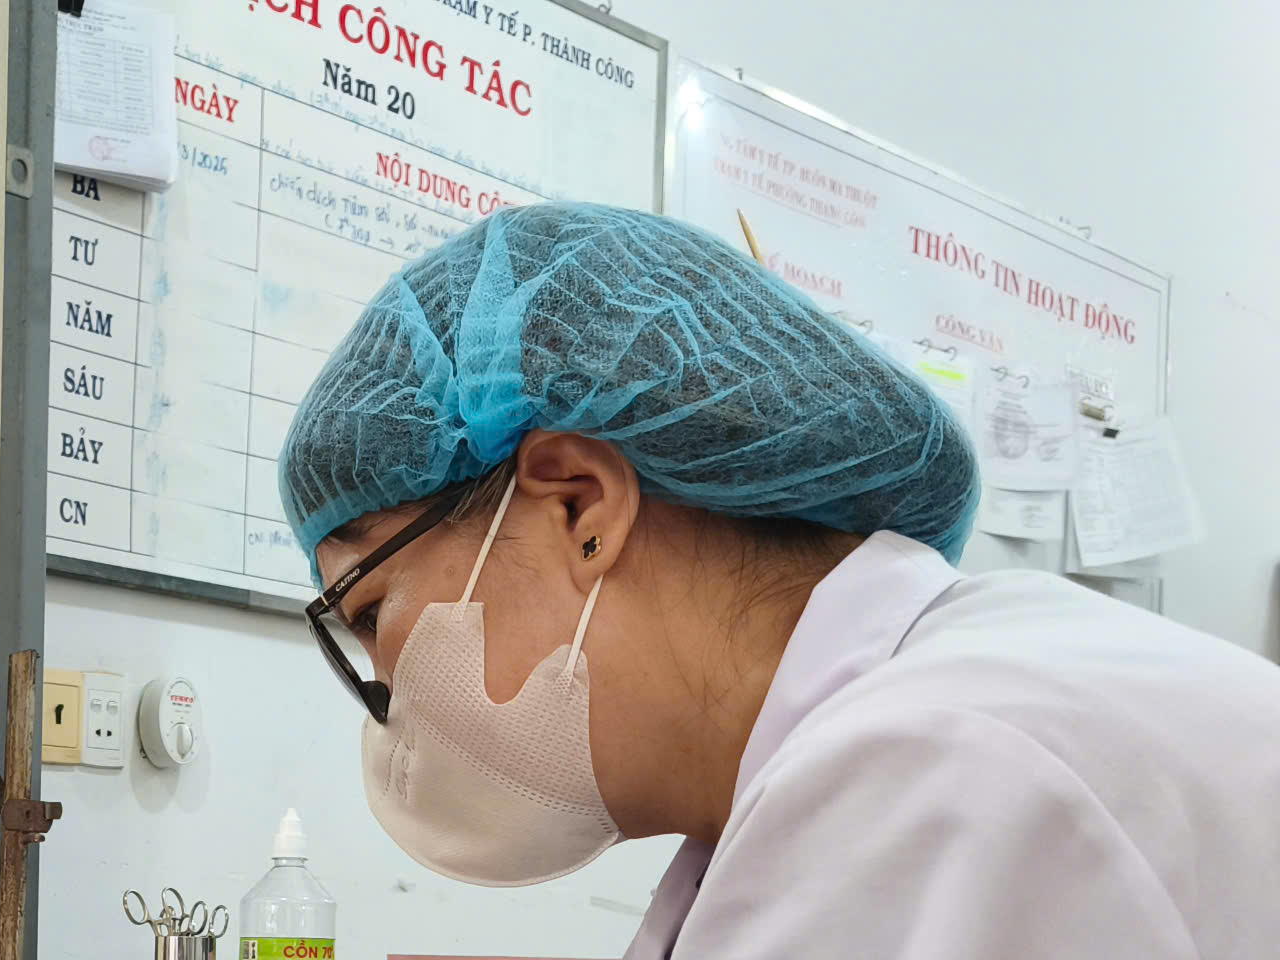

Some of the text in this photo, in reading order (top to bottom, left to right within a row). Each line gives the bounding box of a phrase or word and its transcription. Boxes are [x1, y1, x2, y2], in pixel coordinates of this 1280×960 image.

[338, 4, 448, 81] CÔNG
[460, 57, 533, 117] TÁC
[482, 5, 494, 25] Y
[497, 10, 519, 37] TẾ
[541, 32, 591, 71] THÀNH
[595, 57, 635, 89] CÔNG
[174, 77, 239, 123] NGÀY
[322, 58, 416, 120] Năm 20
[72, 173, 100, 201] BA
[375, 152, 412, 187] NỘI
[418, 167, 471, 209] DUNG
[69, 235, 98, 266] TƯ
[908, 225, 1136, 345] THÔNG TIN HOẠT ĐỘNG
[66, 300, 113, 338] NĂM
[63, 365, 105, 400] SÁU
[61, 427, 103, 464] BẢY
[59, 497, 88, 526] CN
[282, 939, 318, 959] CỒN
